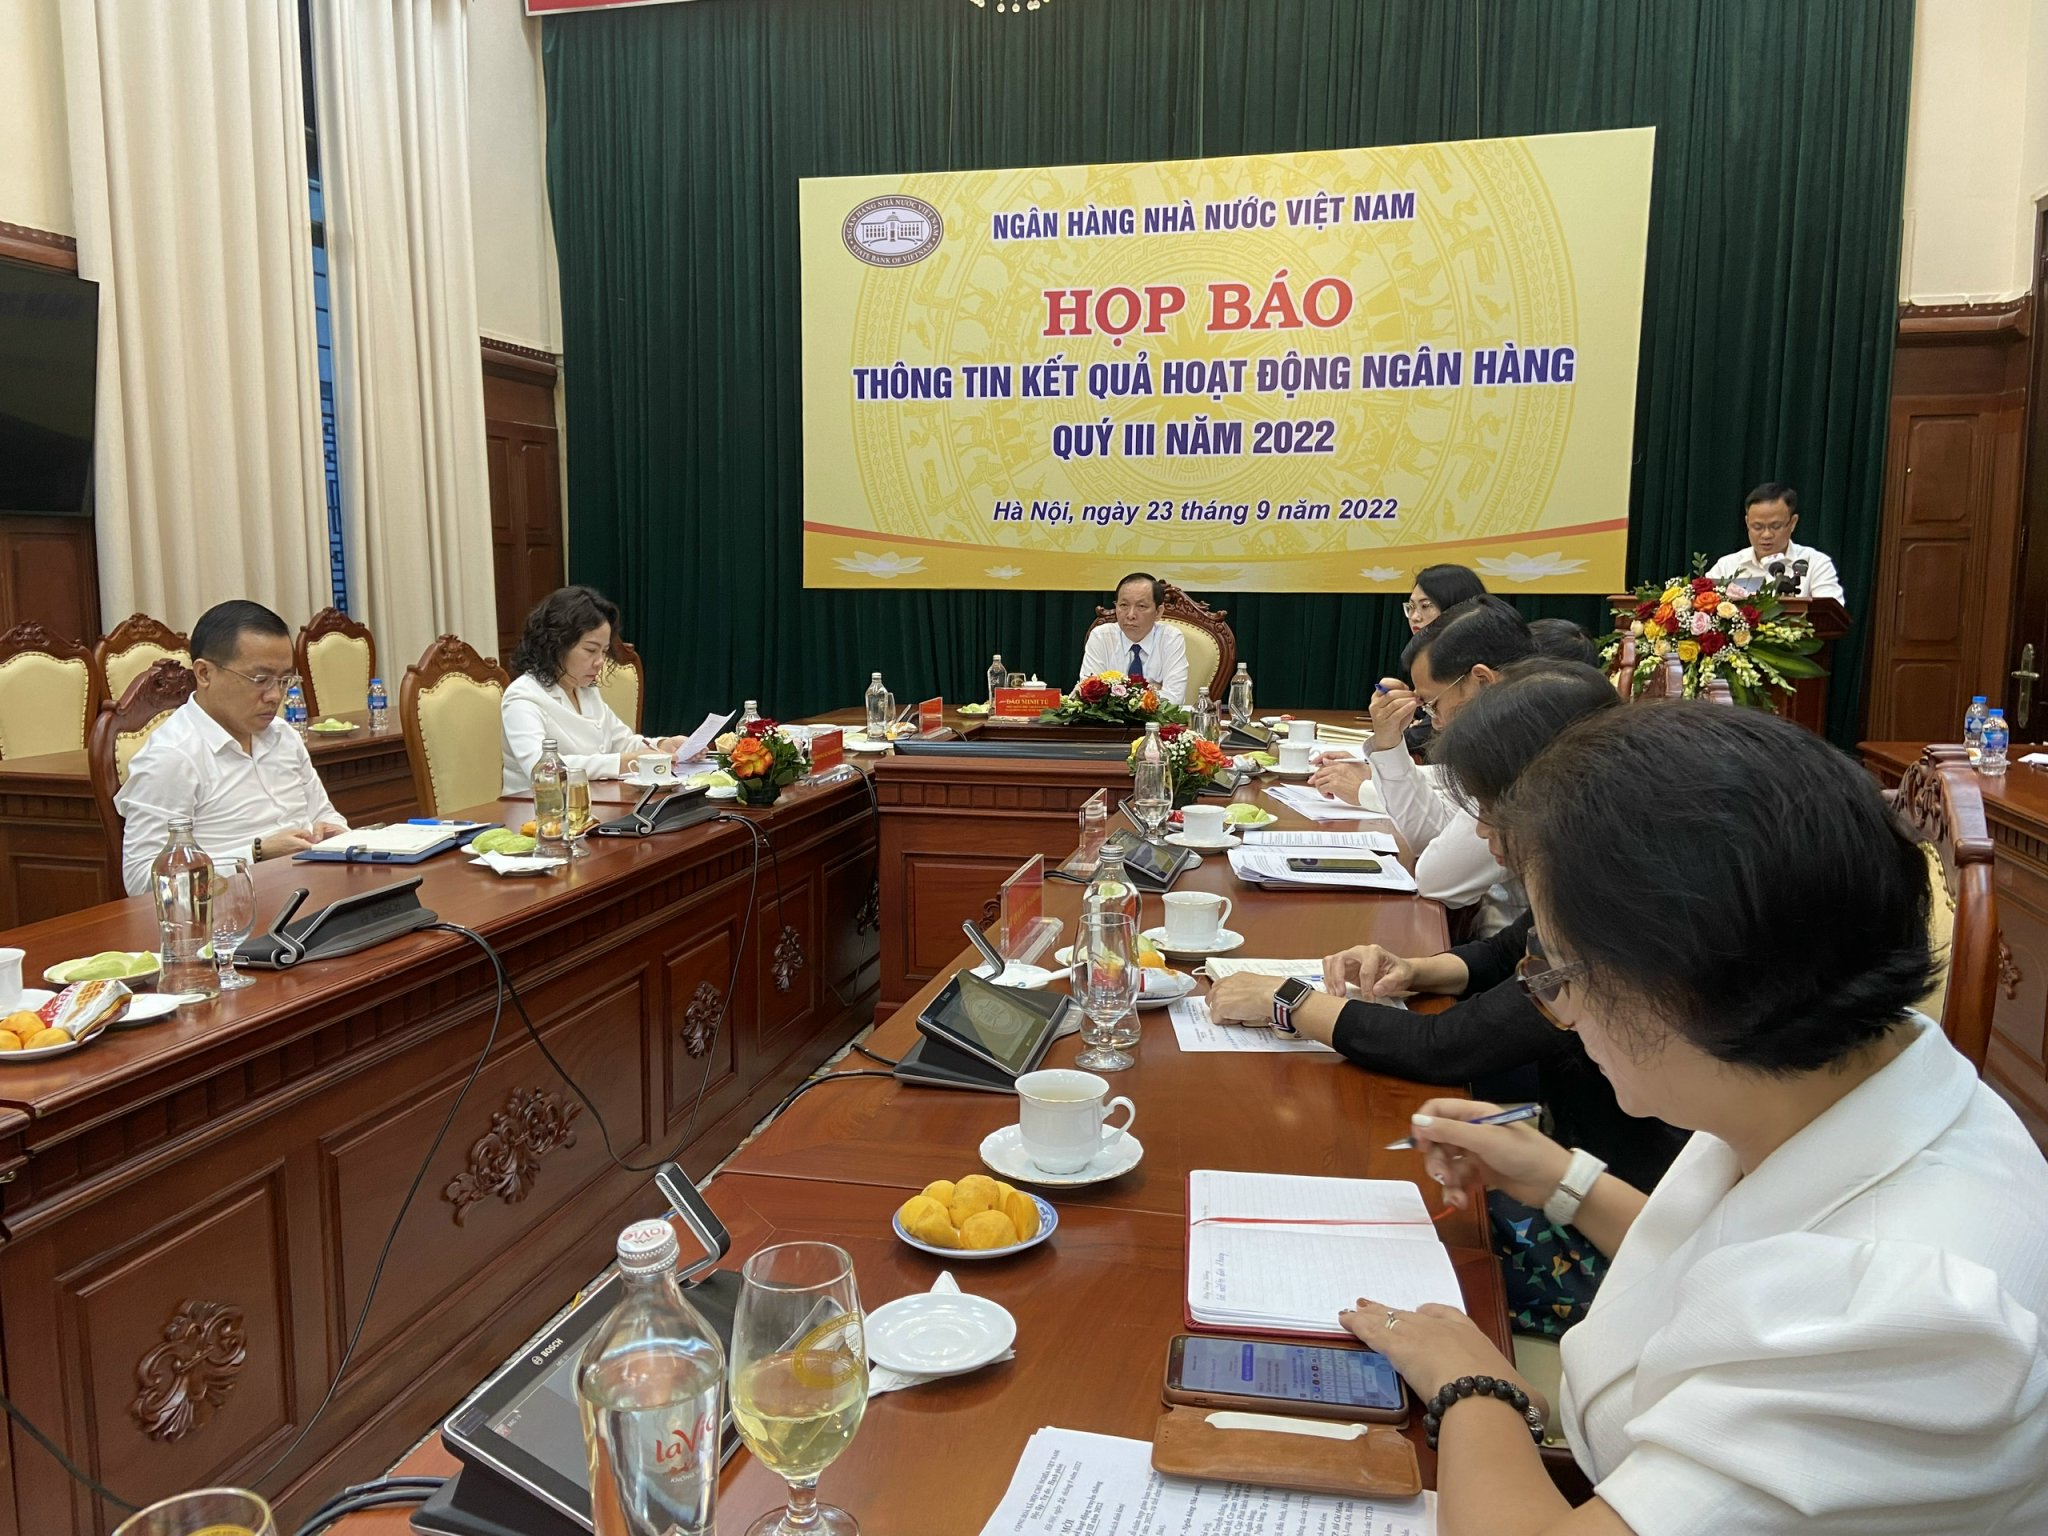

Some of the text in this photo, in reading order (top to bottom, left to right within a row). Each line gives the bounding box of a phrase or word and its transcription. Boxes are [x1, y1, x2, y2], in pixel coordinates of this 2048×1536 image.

[846, 218, 857, 239] NGÂN
[931, 217, 939, 237] NAM
[993, 191, 1416, 240] NGÂN HÀNG NHÀ NƯỚC VIỆT NAM
[852, 243, 872, 259] STATE
[871, 255, 891, 264] BANK
[902, 242, 933, 262] VIETNAM
[1043, 269, 1353, 347] HỌP BÁO
[853, 342, 1575, 400] THÔNG TIN KẾT QUẢ HOẠT ĐỘNG NGÂN HÀNG
[1053, 415, 1335, 460] QUÝ III NĂM 2022
[993, 499, 1398, 526] Hà Nội, ngày 23 tháng 9 năm 2022
[540, 1338, 564, 1357] BOSCH
